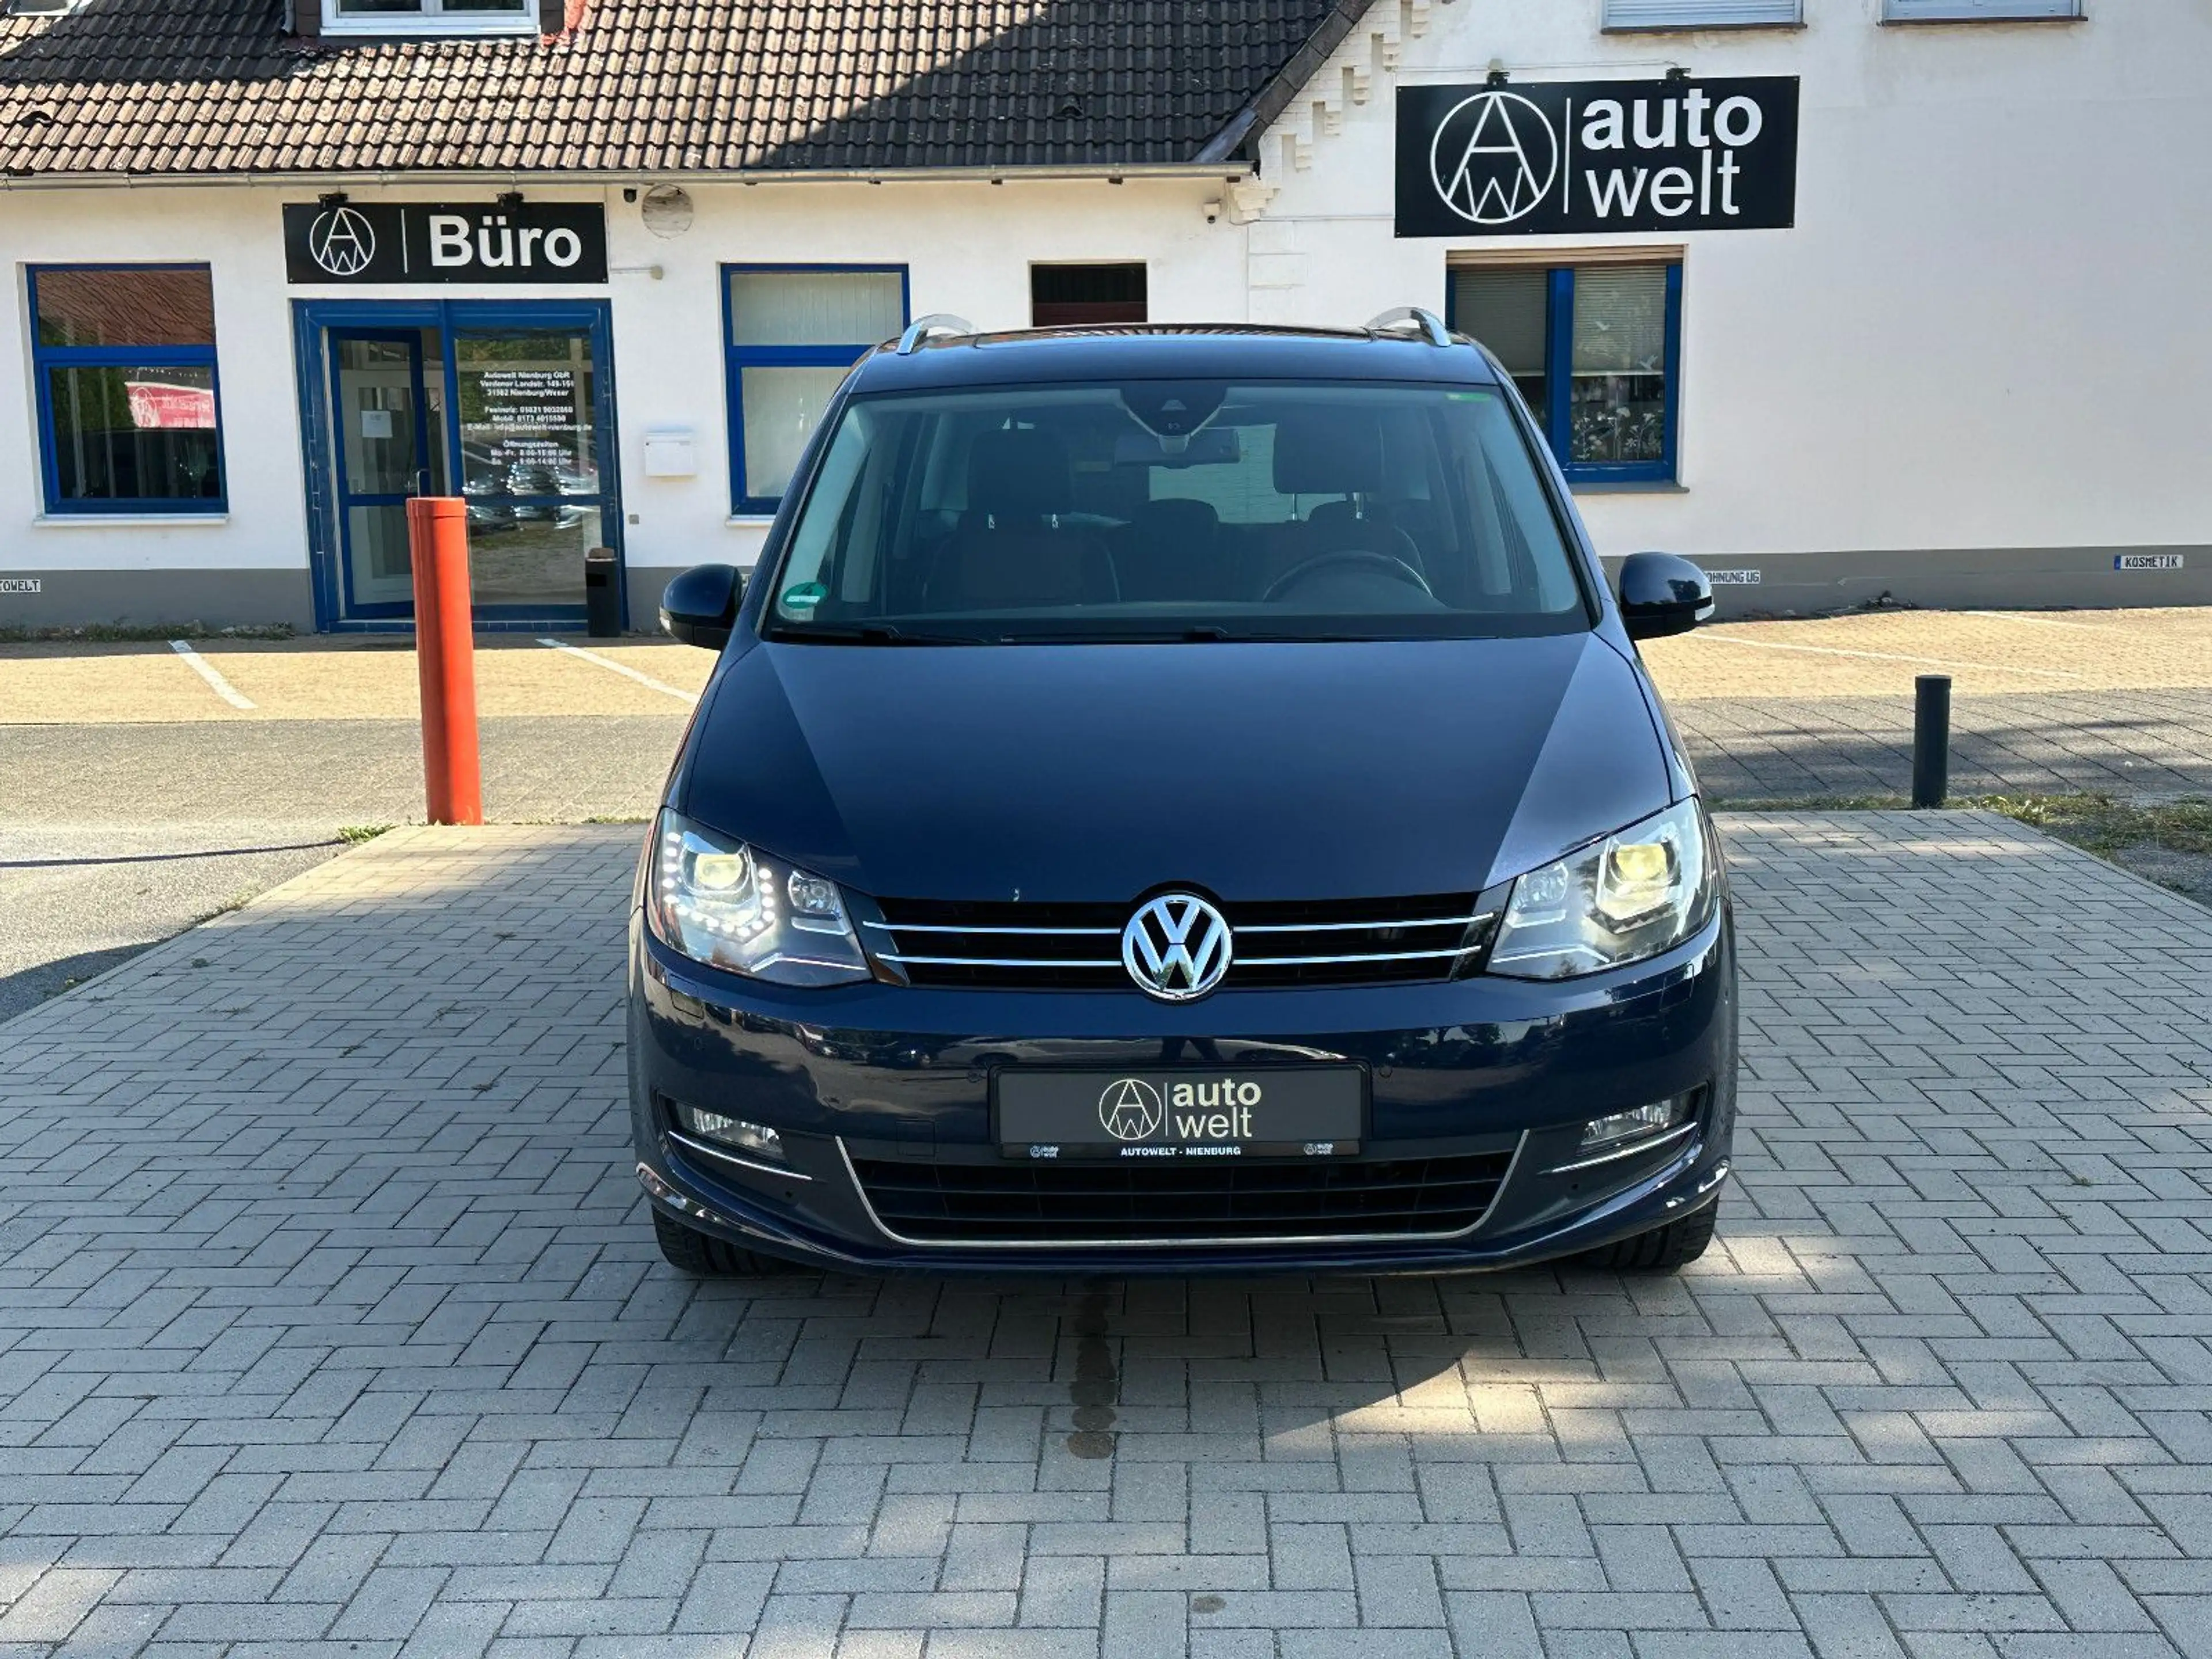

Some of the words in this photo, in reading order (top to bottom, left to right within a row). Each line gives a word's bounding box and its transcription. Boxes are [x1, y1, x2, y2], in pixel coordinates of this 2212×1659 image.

[1581, 88, 1763, 150] auto
[1586, 149, 1740, 218] welt
[429, 215, 582, 267] Büro
[518, 372, 552, 380] Nienburg
[2126, 556, 2177, 567] KOSMETIK
[1172, 1078, 1261, 1107] auto
[1175, 1106, 1252, 1139] welt
[1121, 1147, 1177, 1156] AUTOWELT
[1185, 1147, 1241, 1156] NIENBURG
